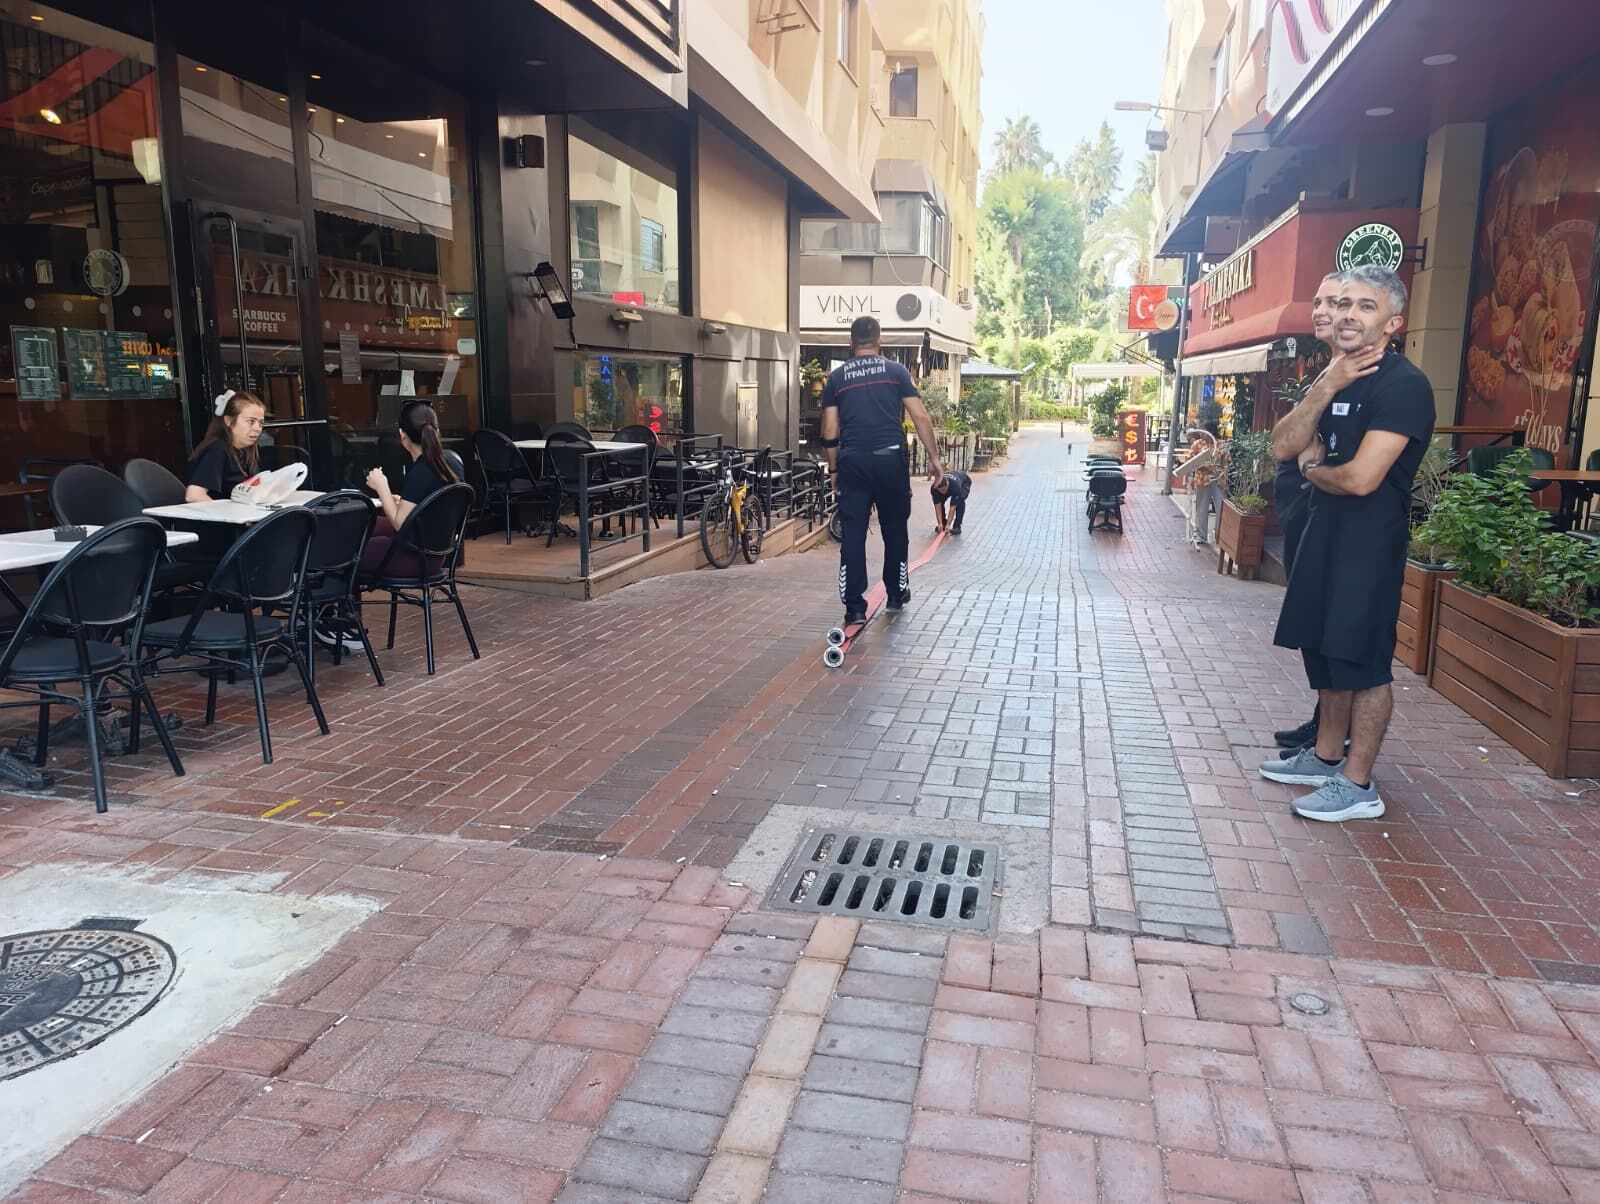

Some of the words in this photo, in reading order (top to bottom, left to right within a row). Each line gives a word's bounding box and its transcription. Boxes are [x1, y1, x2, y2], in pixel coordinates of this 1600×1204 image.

[1345, 224, 1400, 248] GREENBAY
[816, 295, 881, 313] VINYL
[232, 308, 287, 322] SARBUCKS
[244, 321, 279, 333] COFFEE
[1125, 430, 1138, 444] $
